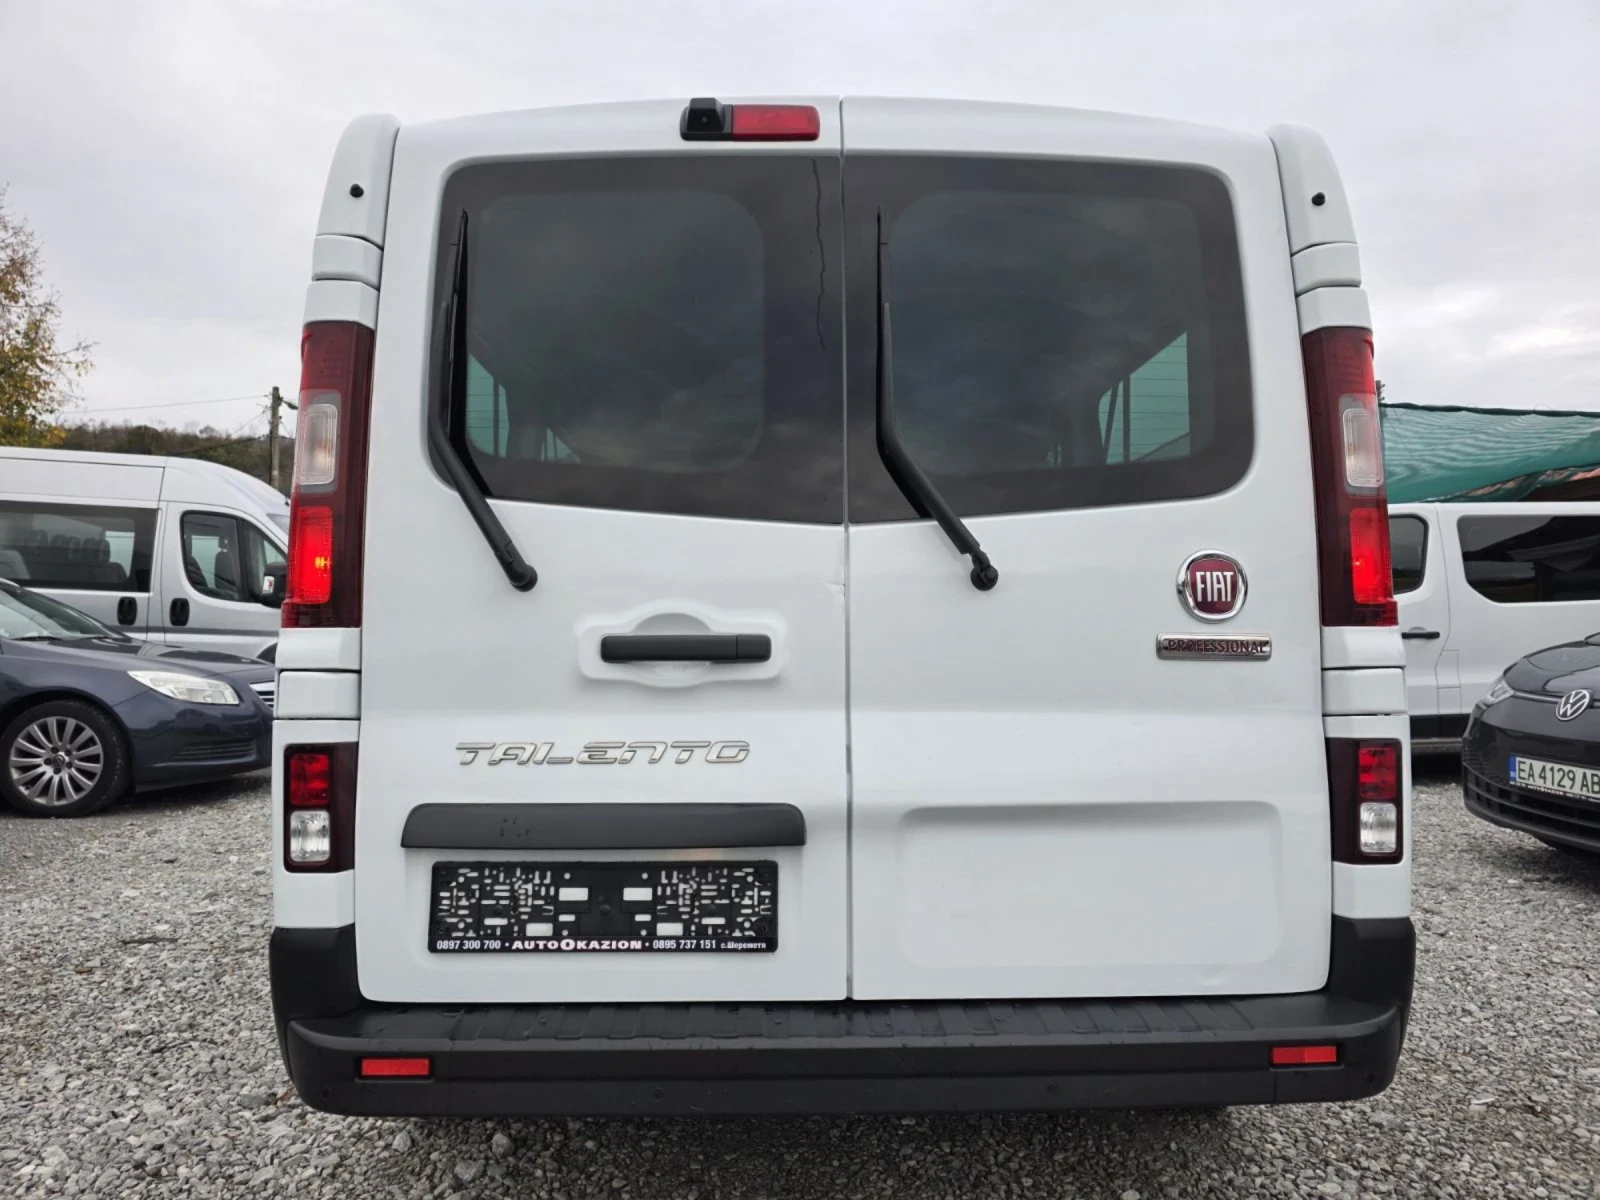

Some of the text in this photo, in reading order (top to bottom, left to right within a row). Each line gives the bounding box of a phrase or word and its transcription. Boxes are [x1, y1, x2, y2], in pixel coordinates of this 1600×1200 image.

[1196, 571, 1234, 602] FIAT
[1167, 639, 1267, 653] PROFESSIONAL
[456, 740, 751, 765] TALENTO
[1517, 760, 1536, 782] EA
[1538, 765, 1576, 790] 4129
[1580, 771, 1600, 795] AB
[436, 939, 460, 950] 0897
[462, 939, 481, 950] 300
[483, 939, 501, 950] 700
[652, 939, 677, 949] 0895
[679, 939, 697, 949] 737
[700, 939, 716, 949] 151
